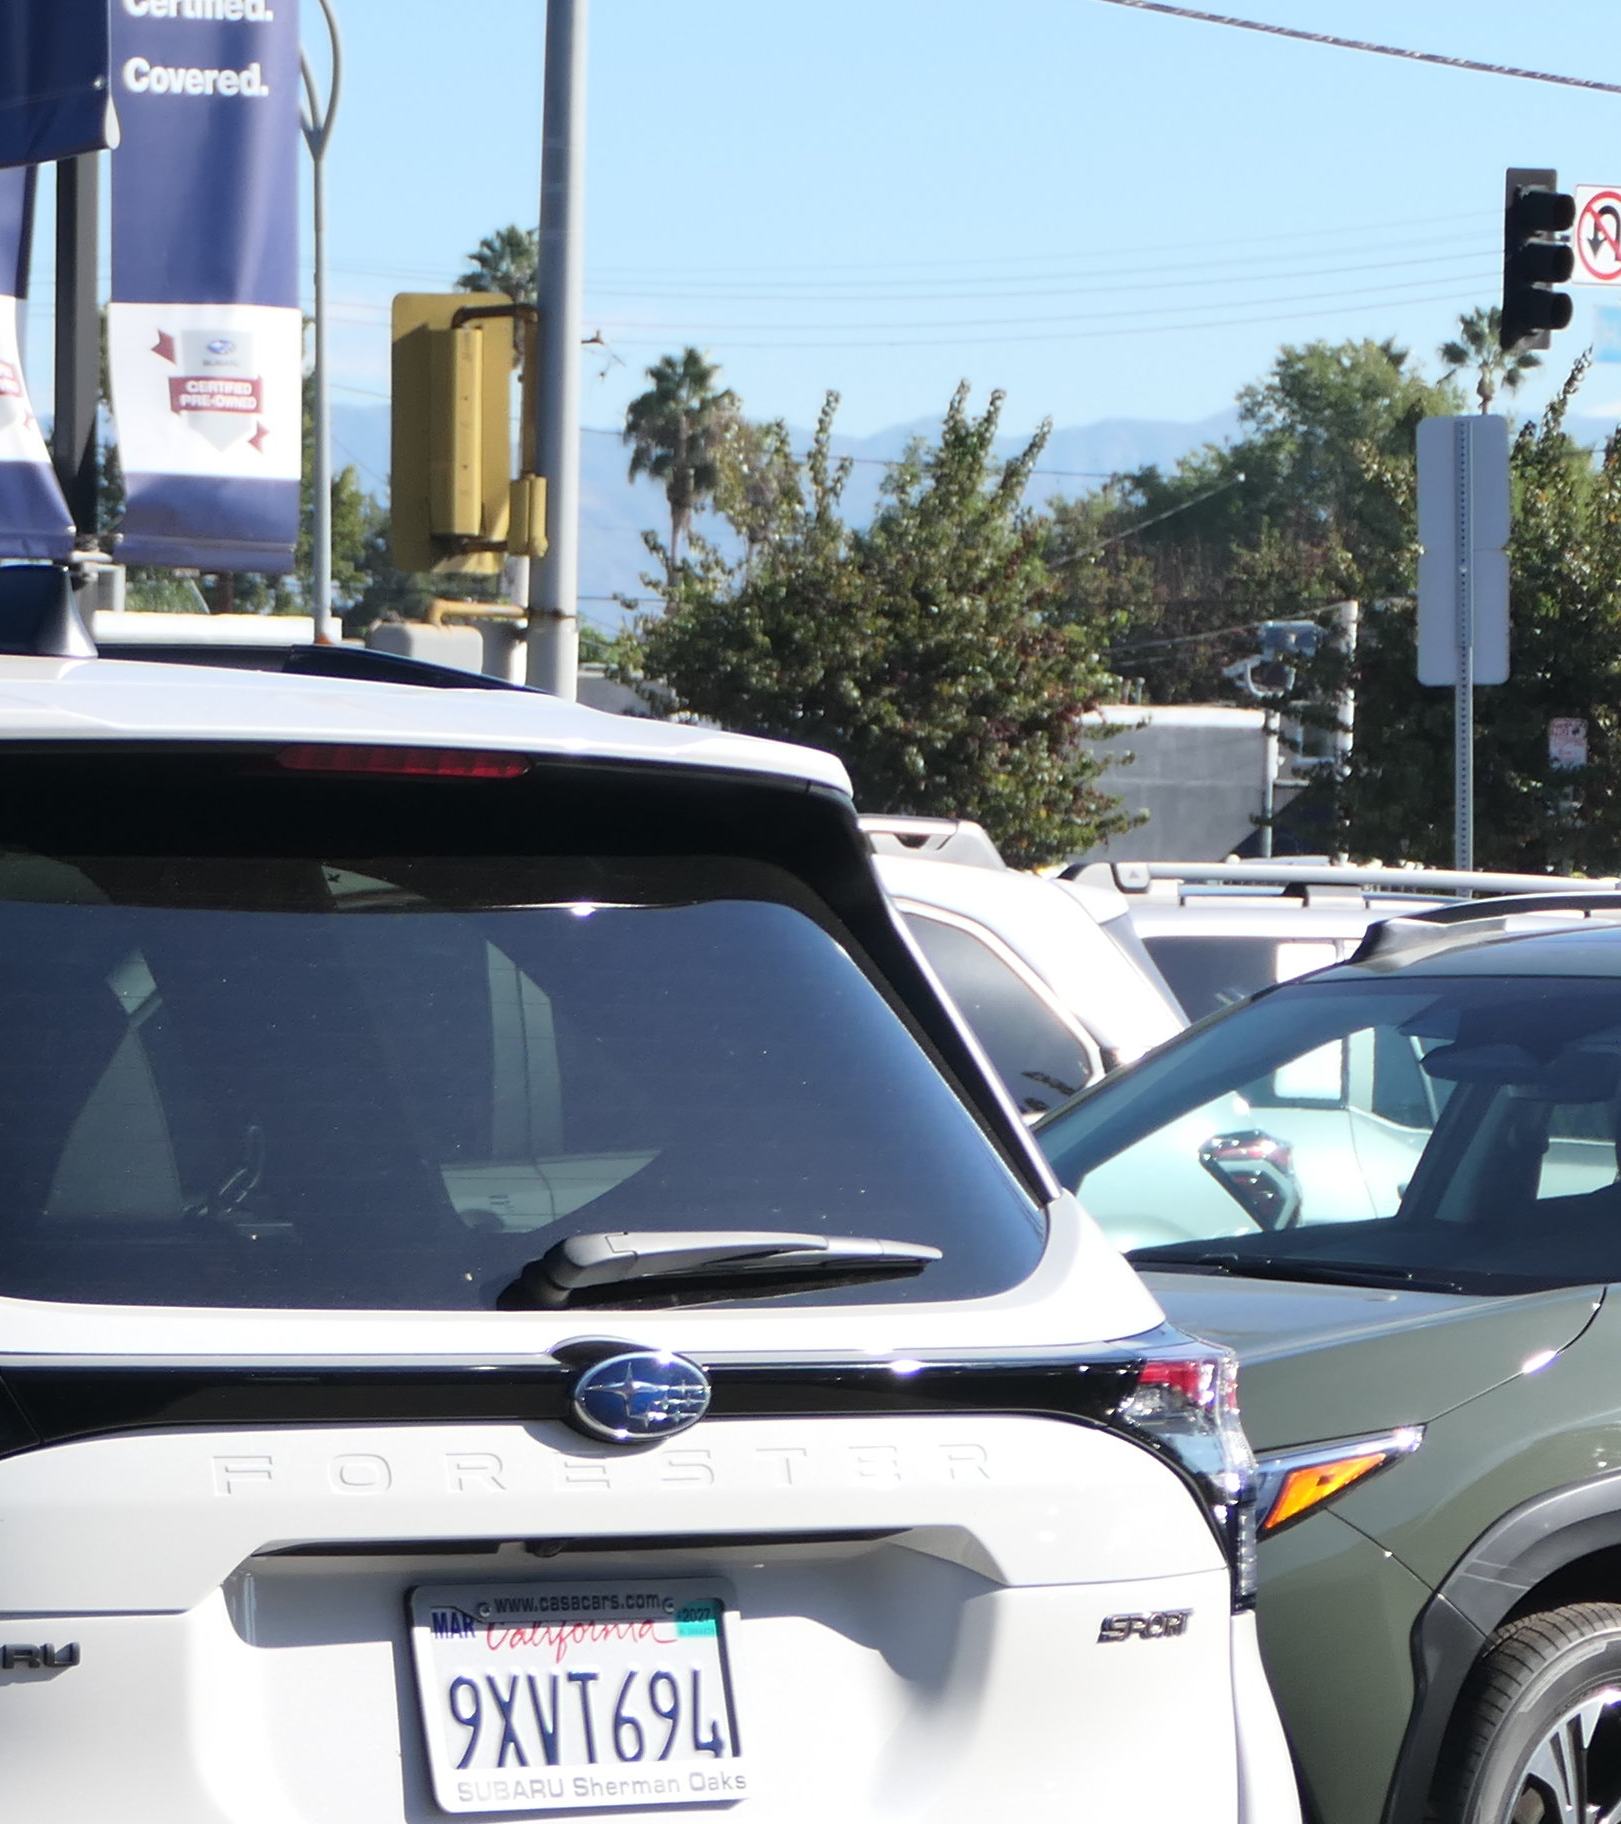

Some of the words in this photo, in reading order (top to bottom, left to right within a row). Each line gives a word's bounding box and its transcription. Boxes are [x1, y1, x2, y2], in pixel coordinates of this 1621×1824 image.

[122, 56, 270, 97] Covered.
[179, 394, 257, 410] PRE-OWNED
[212, 1443, 994, 1496] FORESTER
[494, 1593, 662, 1614] www.casacars.com
[432, 1610, 477, 1639] MAR
[485, 1619, 677, 1664] California
[448, 1666, 726, 1771] 9XVT694
[457, 1776, 565, 1803] SUBARU
[572, 1774, 682, 1798] Sherman
[687, 1770, 748, 1793] Oaks
